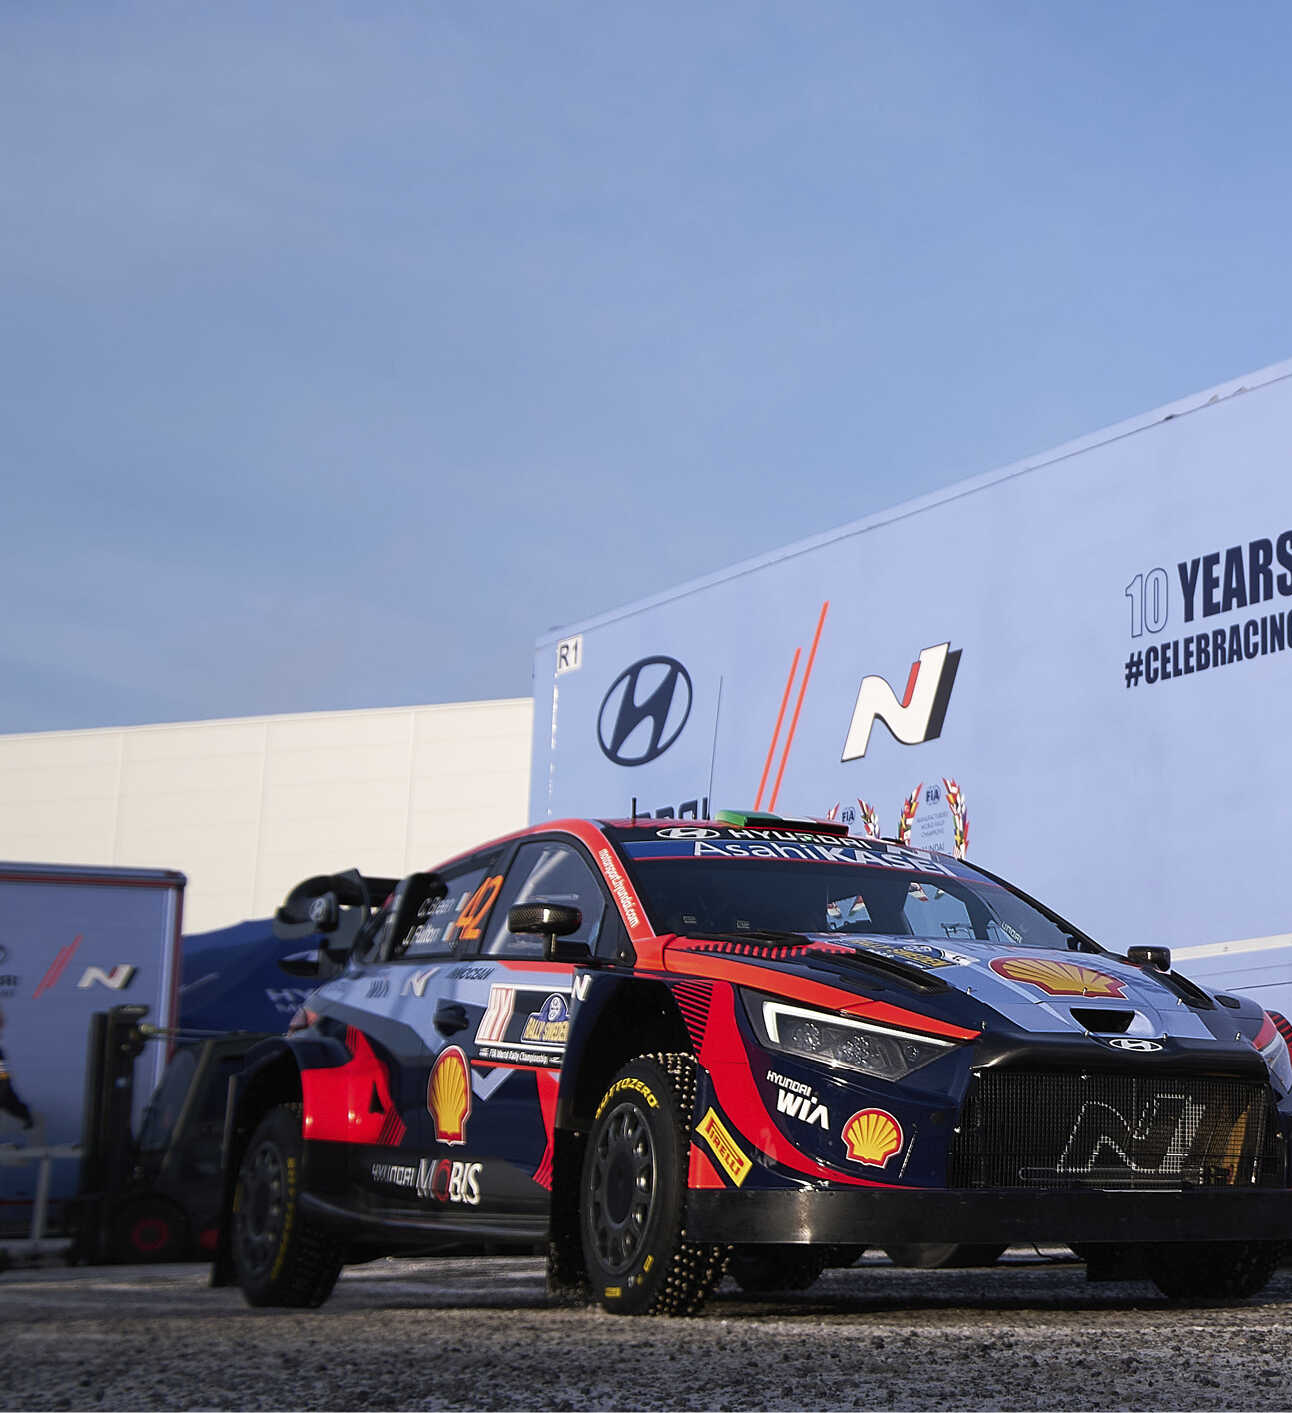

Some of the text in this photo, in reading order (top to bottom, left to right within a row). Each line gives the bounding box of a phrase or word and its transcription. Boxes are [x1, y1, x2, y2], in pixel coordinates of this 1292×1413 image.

[1125, 567, 1169, 639] 10
[559, 640, 578, 669] R1
[841, 810, 855, 822] FIA
[926, 789, 940, 802] FIA
[727, 829, 872, 849] HYUNDAI
[455, 875, 505, 940] 42
[599, 848, 640, 929] motorsport.hyundai.com
[766, 1070, 812, 1097] HYUNDAI
[777, 1089, 830, 1130] WIA
[705, 1117, 744, 1176] PIRELLI
[415, 1158, 483, 1206] MOBIS
